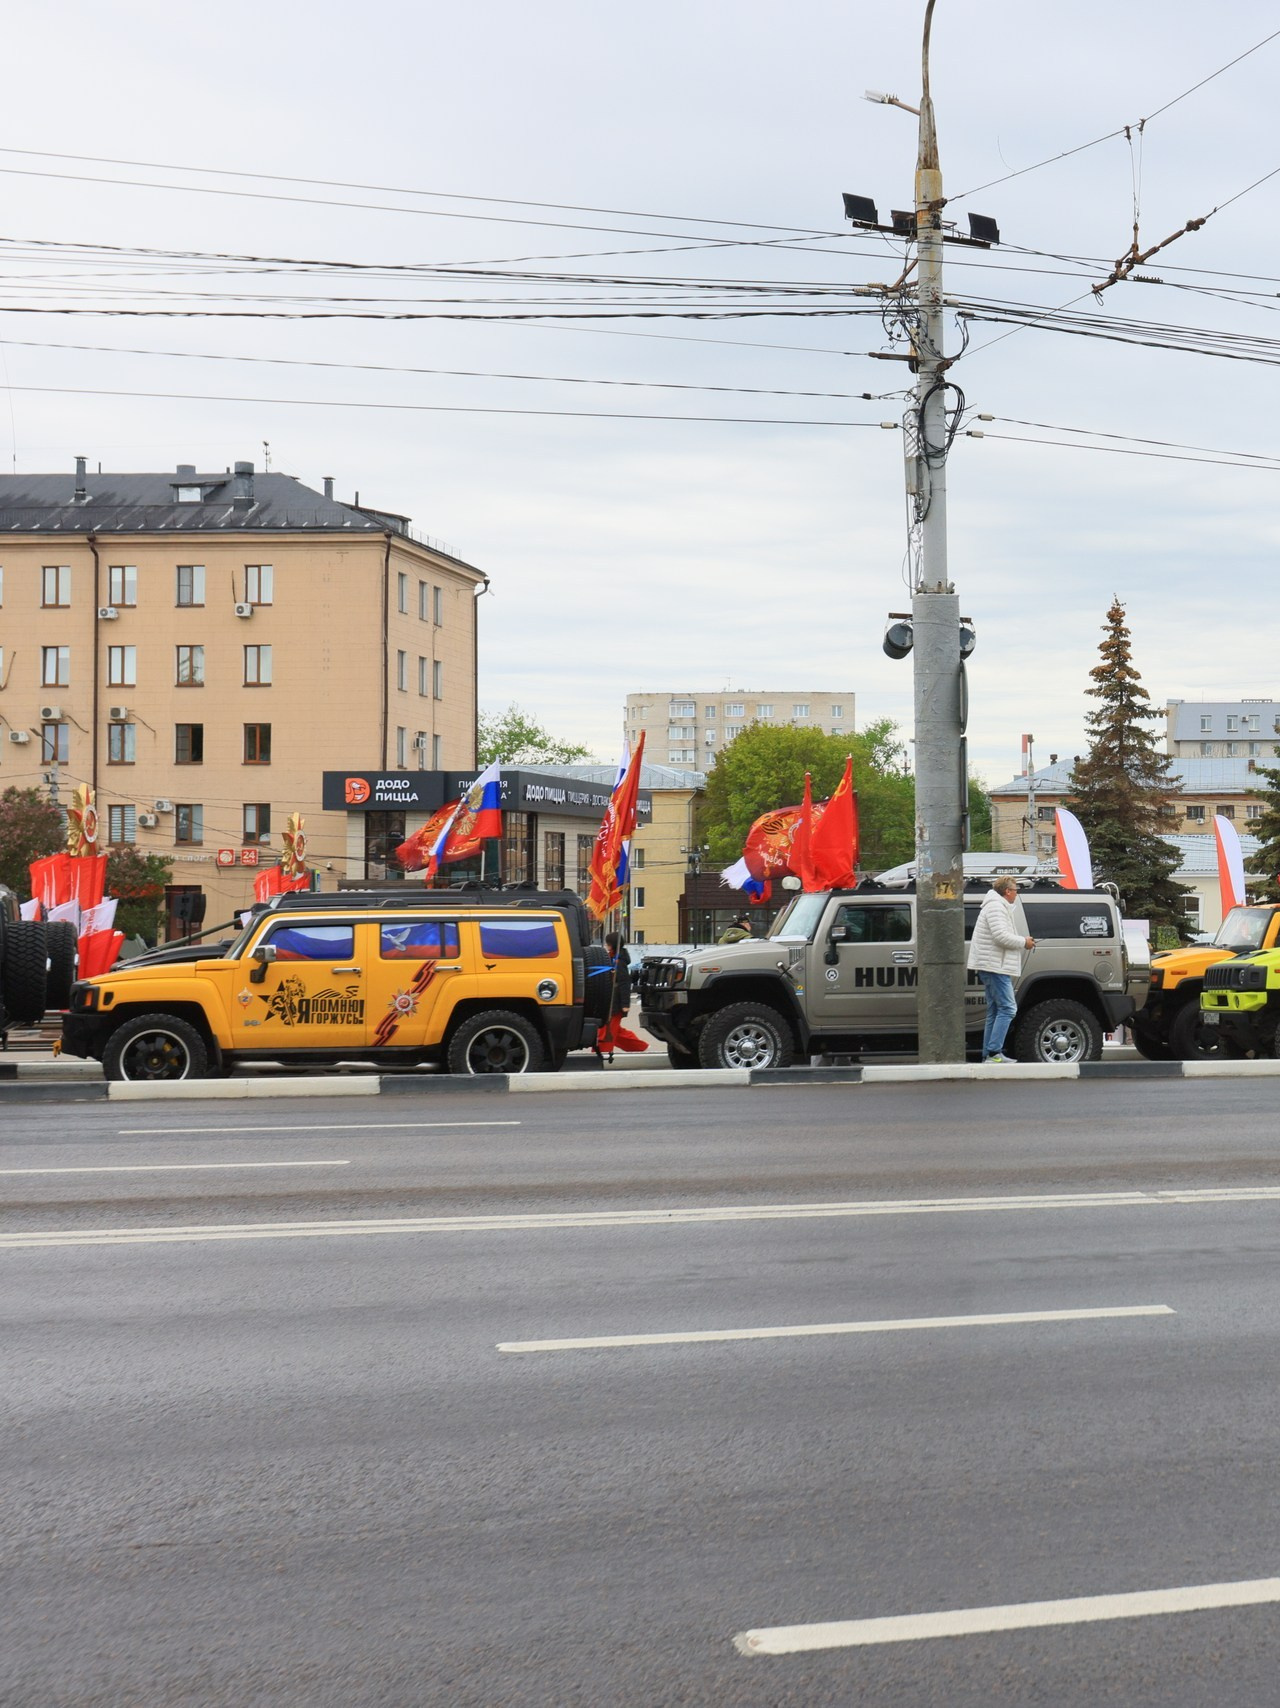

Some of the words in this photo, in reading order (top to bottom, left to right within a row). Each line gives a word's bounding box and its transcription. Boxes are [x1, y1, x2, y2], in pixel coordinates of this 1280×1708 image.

[375, 780, 410, 790] ДОДО
[375, 792, 419, 802] ПИЦЦА
[526, 784, 545, 802] ДОДО
[545, 786, 566, 803] ПИЦЦА
[243, 851, 255, 859] 24
